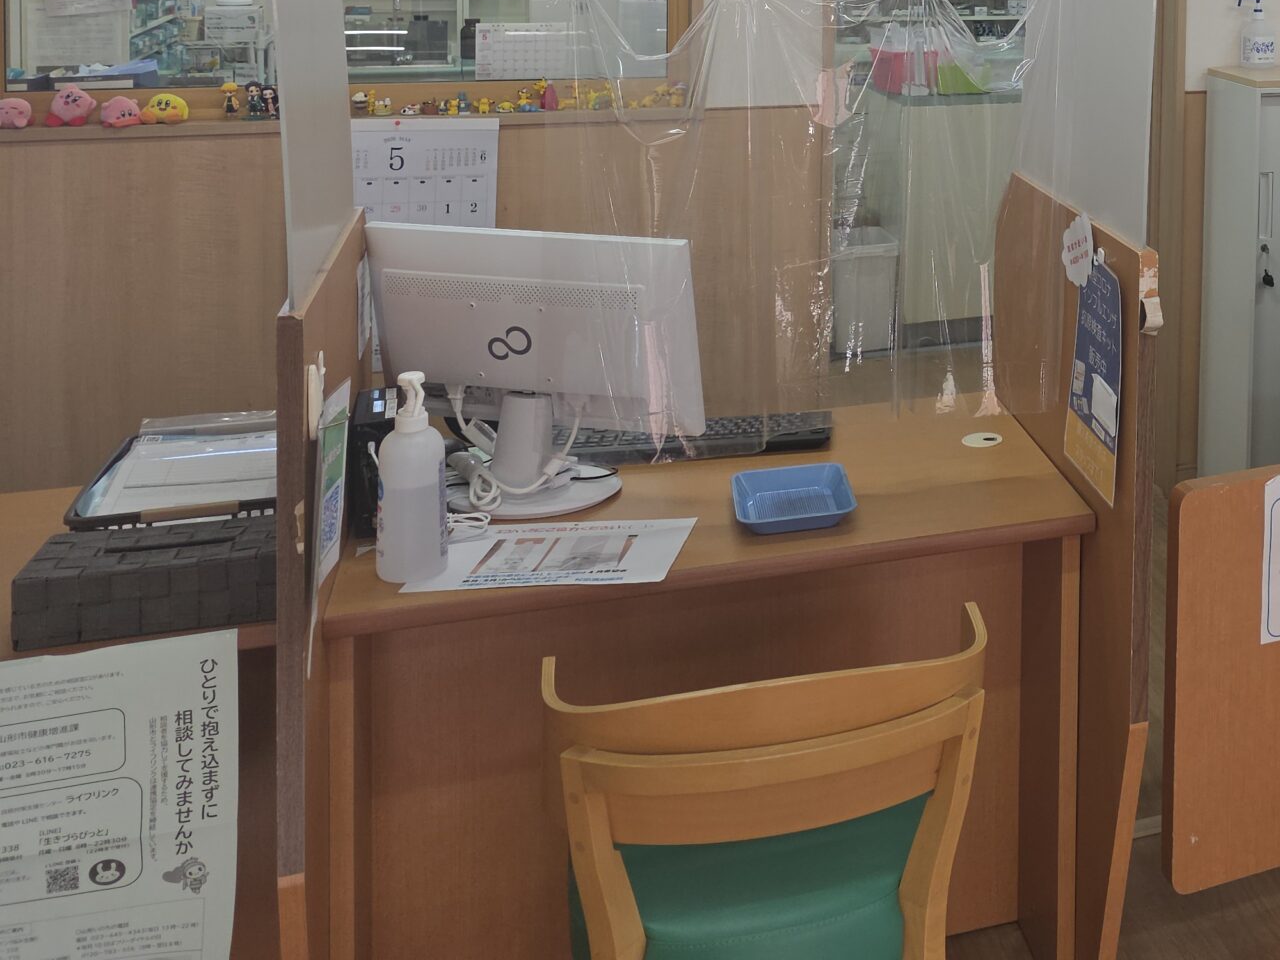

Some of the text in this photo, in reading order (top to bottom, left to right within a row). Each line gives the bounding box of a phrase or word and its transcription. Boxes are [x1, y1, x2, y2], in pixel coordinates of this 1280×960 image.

[389, 146, 405, 171] 5
[480, 152, 487, 161] 6
[445, 203, 451, 215] 1
[470, 202, 478, 214] 2
[200, 657, 220, 820] ひとりで抱え込まずに
[174, 709, 194, 856] 相談してみませんか
[65, 787, 120, 804] ライフリンク
